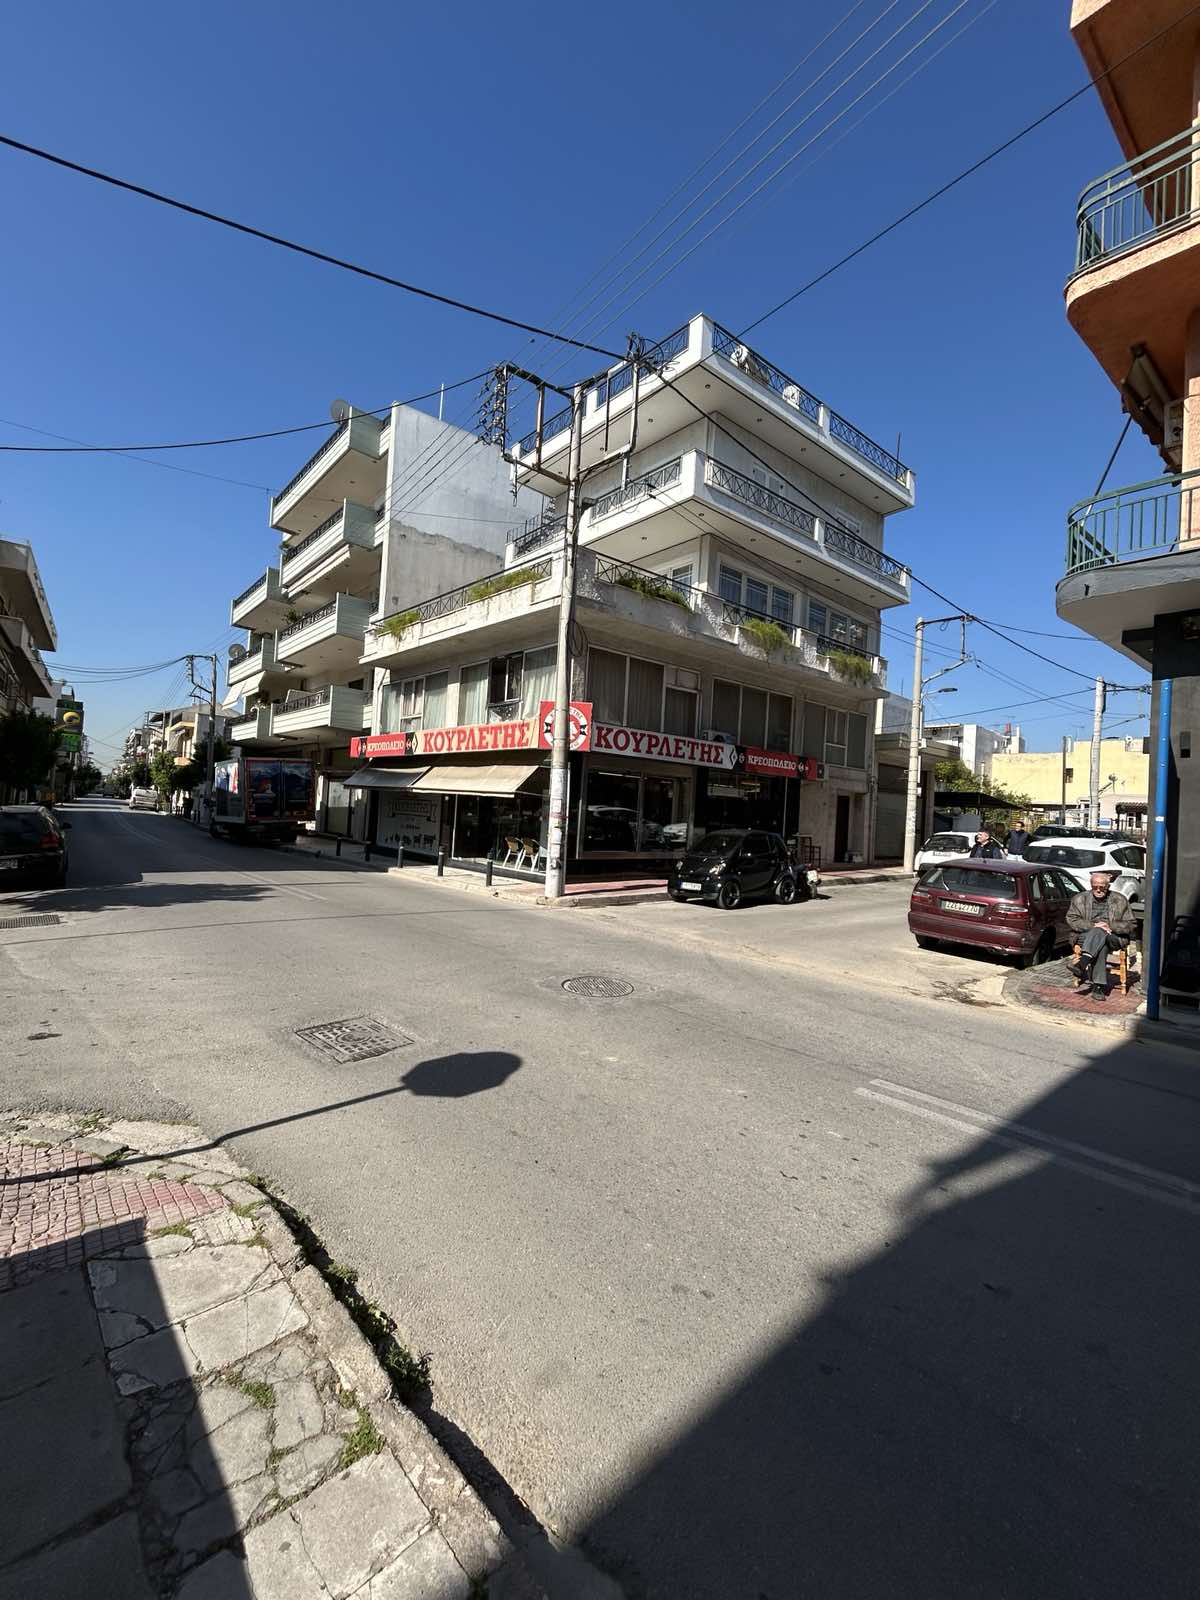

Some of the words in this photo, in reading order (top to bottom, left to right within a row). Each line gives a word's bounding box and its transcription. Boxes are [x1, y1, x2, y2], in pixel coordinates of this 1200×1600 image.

[422, 722, 531, 753] ΚΟΥΡΛΕΤΗΣ
[594, 726, 725, 764] ΚΟΥΡΛΕΤΗΣ
[747, 755, 797, 770] ΚΡΕΟΠΩΛΕΙΟ
